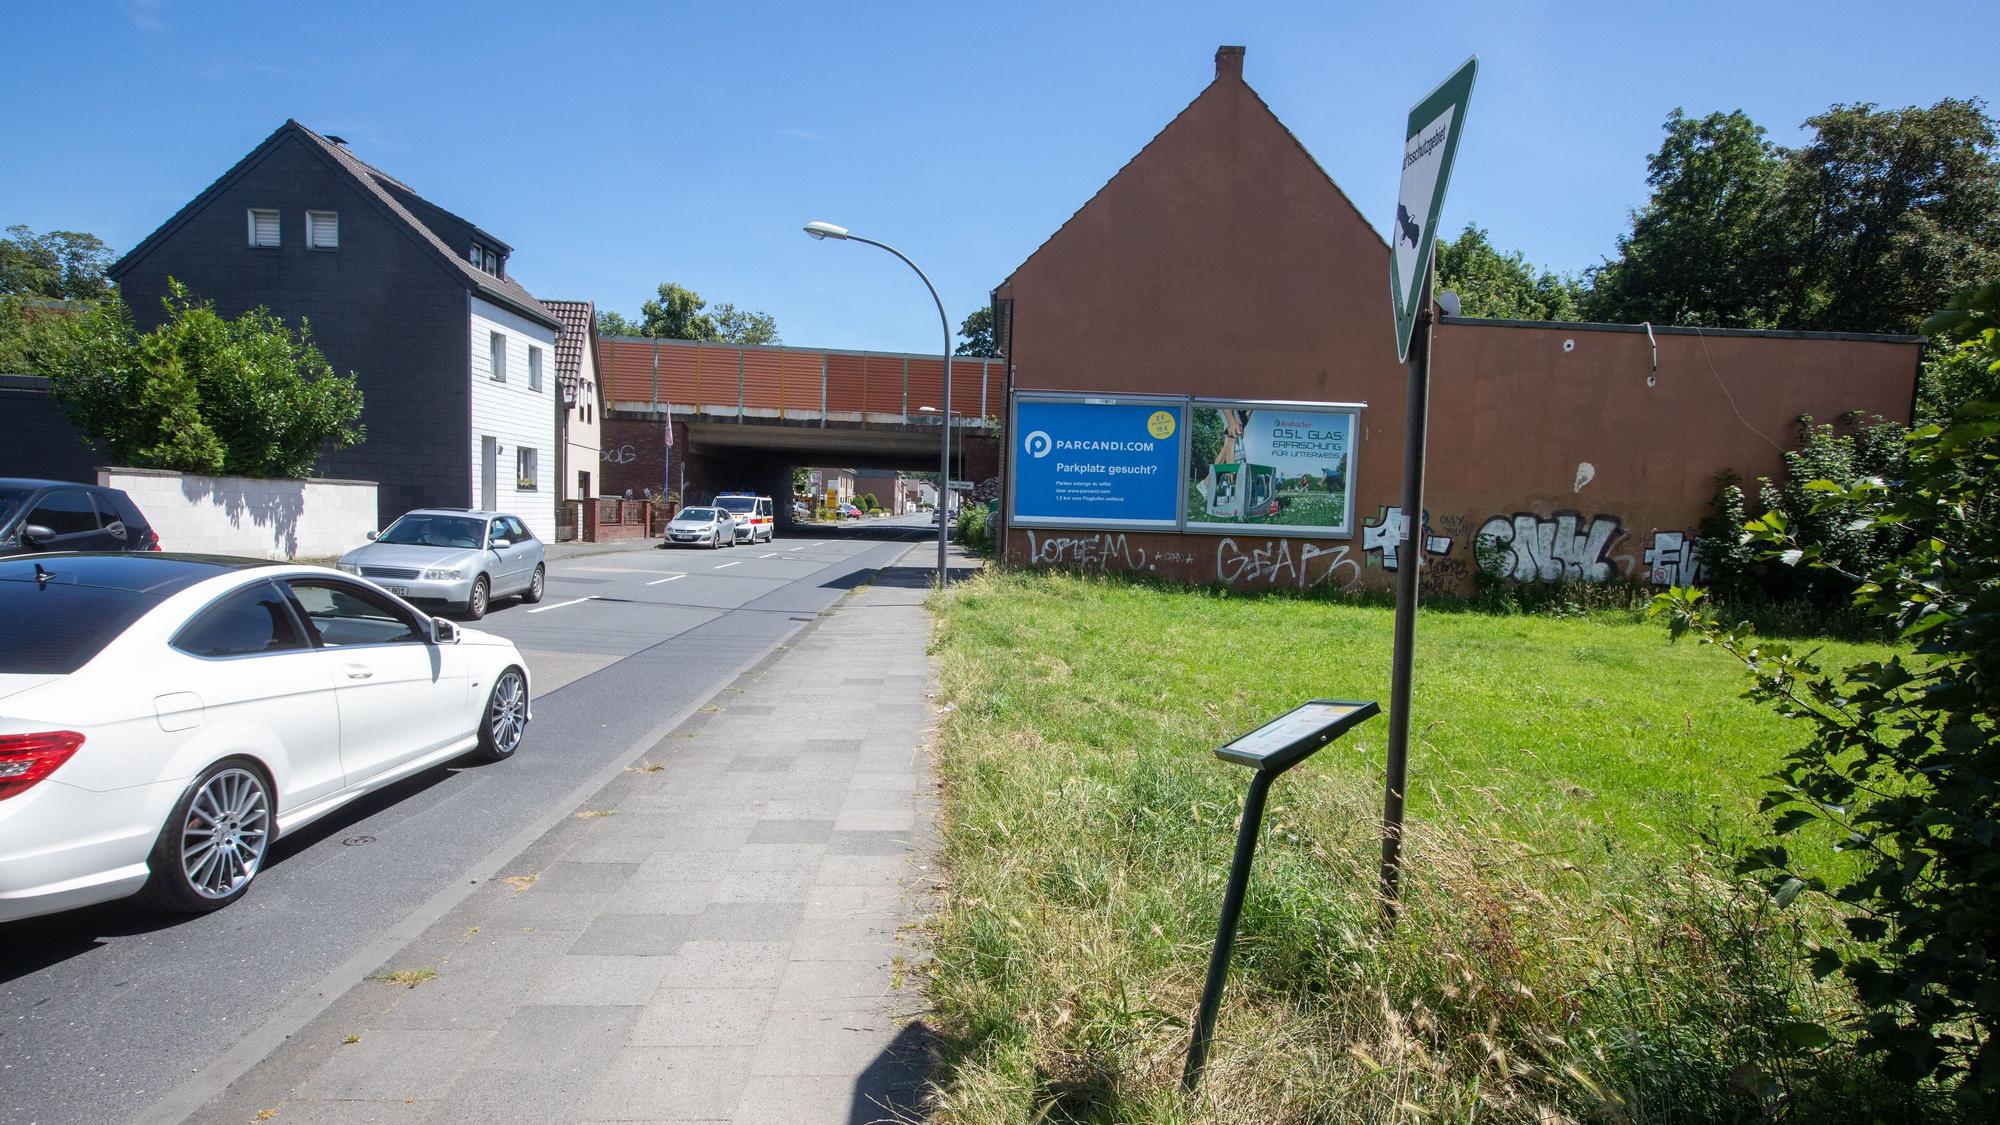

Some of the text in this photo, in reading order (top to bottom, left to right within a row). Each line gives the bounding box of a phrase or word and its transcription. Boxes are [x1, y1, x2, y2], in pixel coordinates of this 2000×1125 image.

[1056, 440, 1154, 452] PARCANDI.COM
[1272, 440, 1342, 451] ERFRISCHUNG
[1290, 451, 1340, 459] UNTERWEGS
[1056, 463, 1158, 476] Parkplatz gesucht?
